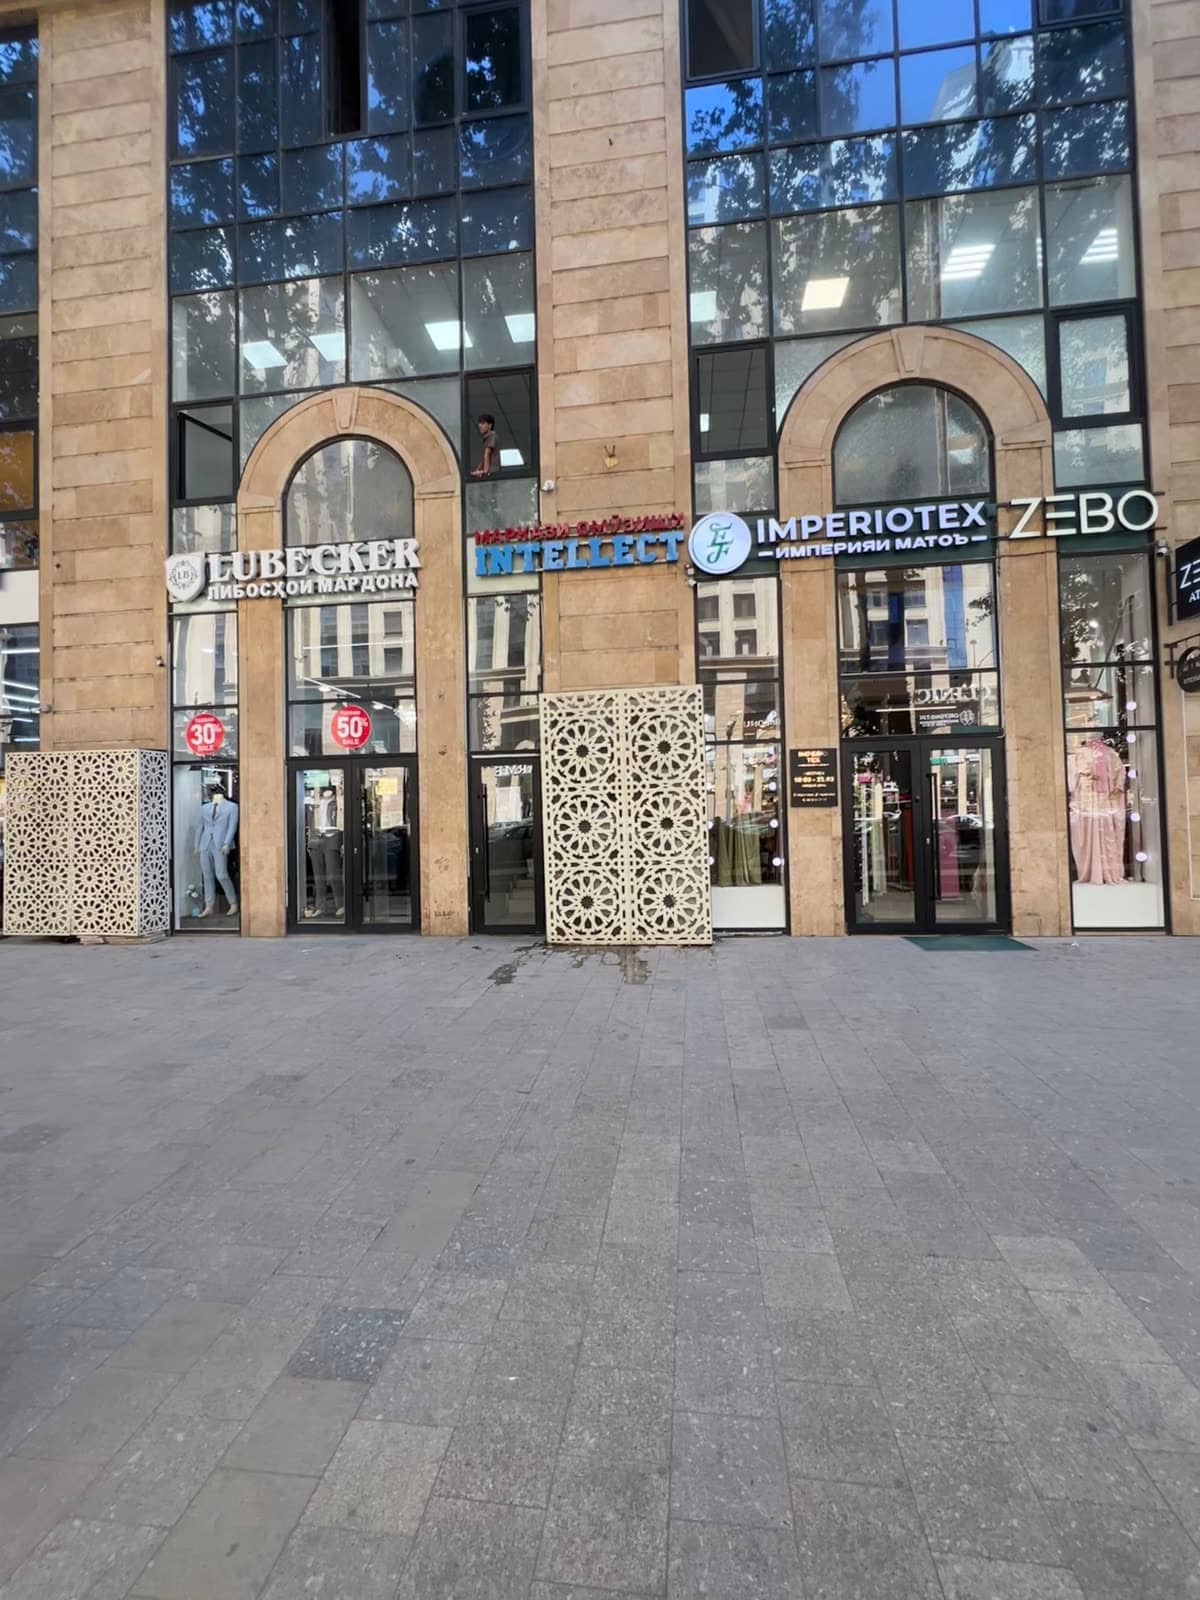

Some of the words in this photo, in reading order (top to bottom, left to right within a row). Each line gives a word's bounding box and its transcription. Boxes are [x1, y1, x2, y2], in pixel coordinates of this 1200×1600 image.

[757, 501, 987, 543] IMPERIOTEX
[1009, 489, 1159, 539] ZEBO
[208, 538, 422, 582] LUBECKER
[475, 530, 685, 577] INTELLECT
[775, 539, 890, 560] ИМПЕРИЯИ
[895, 533, 969, 550] МАТОЪ
[318, 572, 419, 594] МАРДОНА
